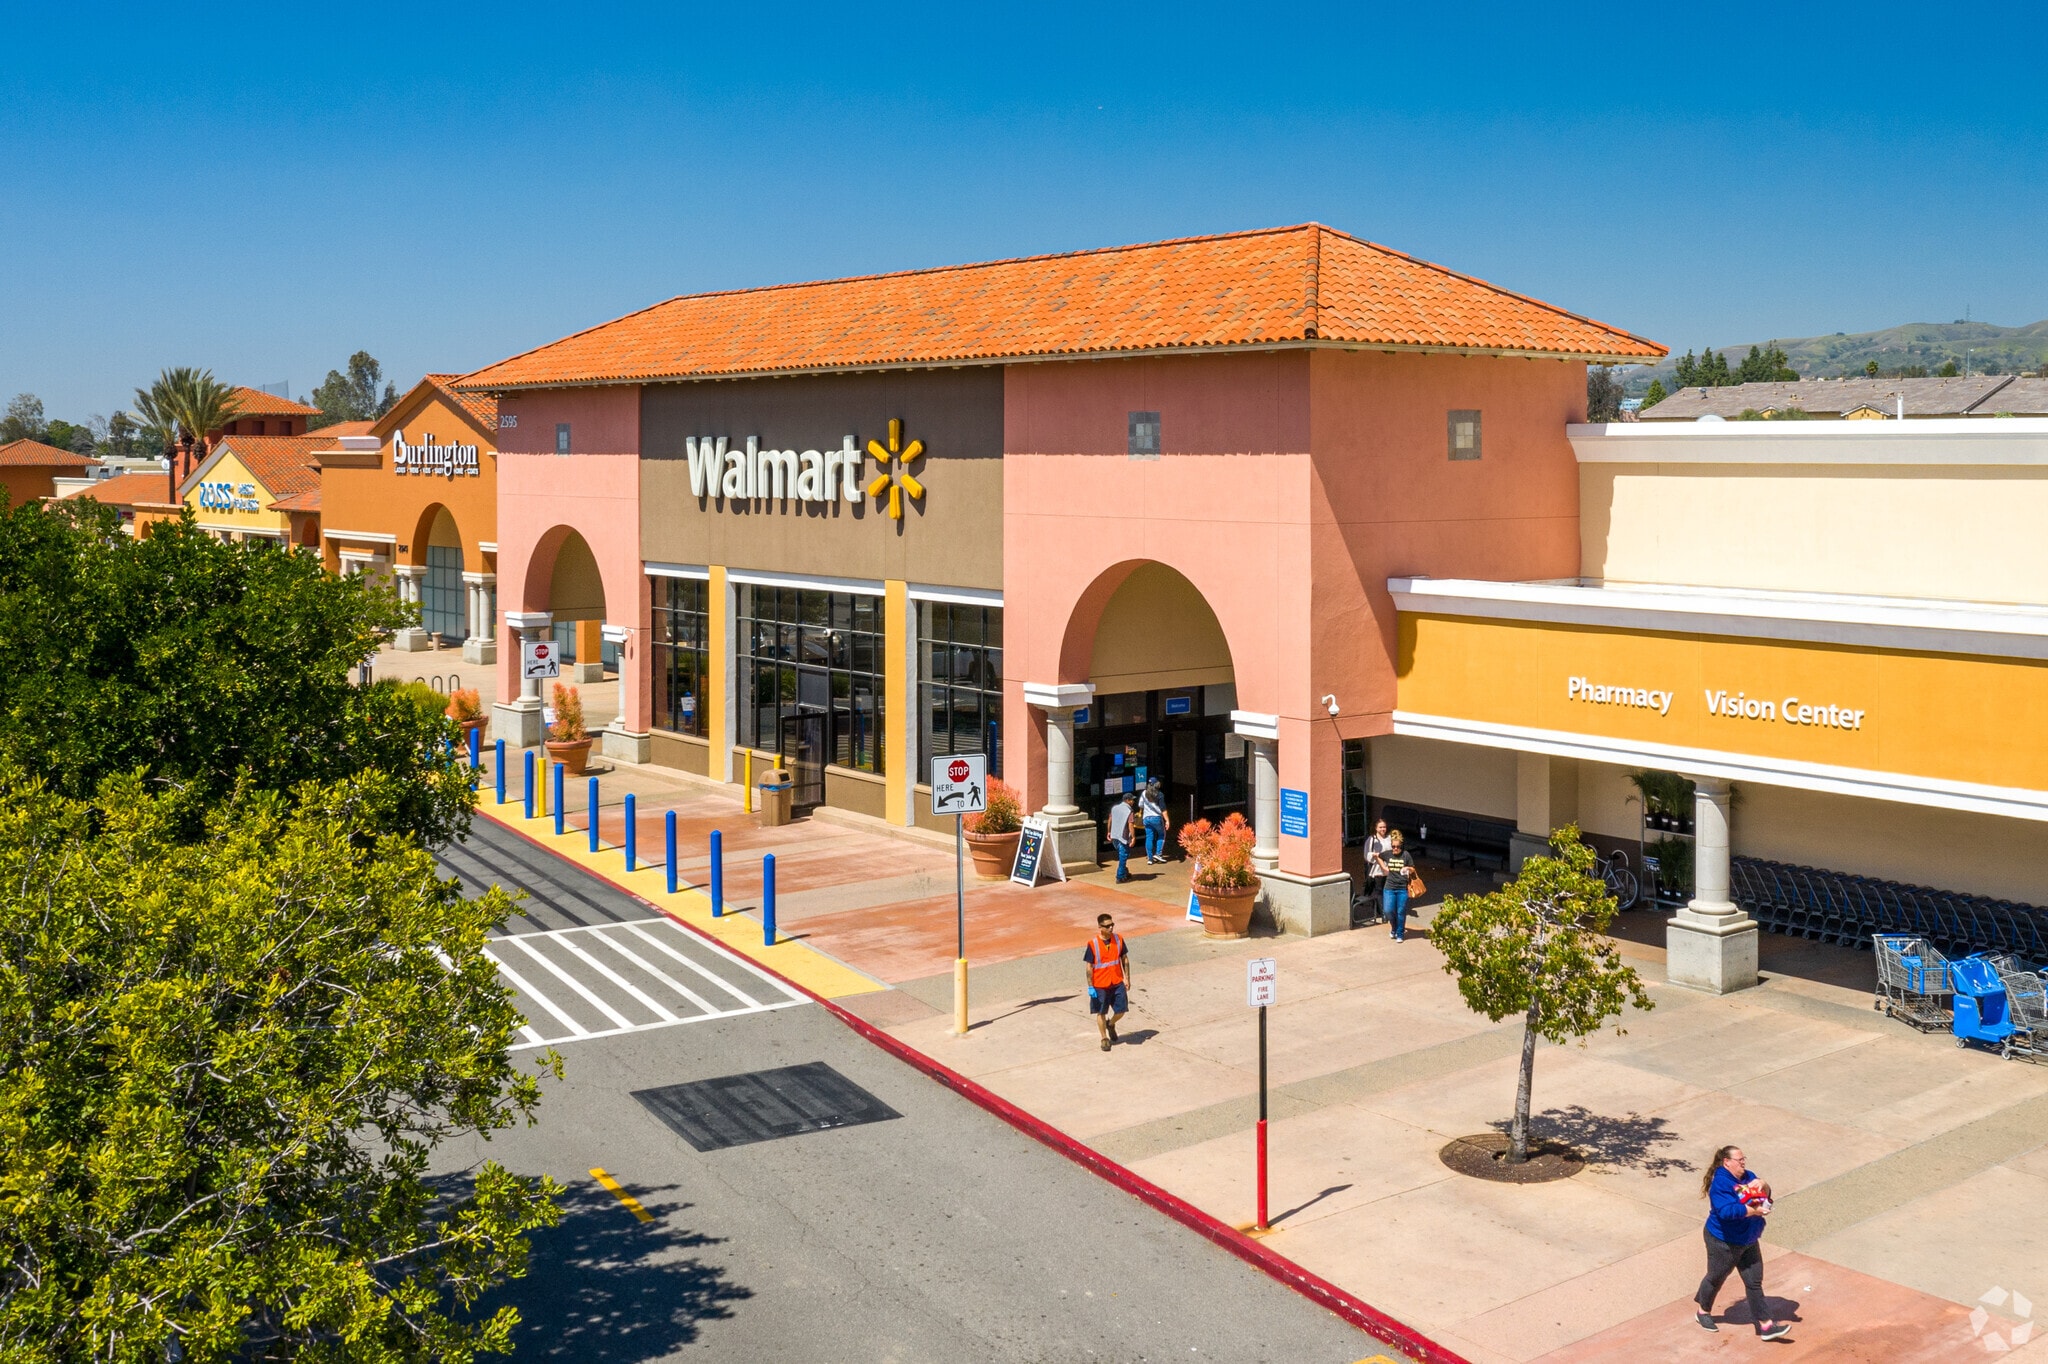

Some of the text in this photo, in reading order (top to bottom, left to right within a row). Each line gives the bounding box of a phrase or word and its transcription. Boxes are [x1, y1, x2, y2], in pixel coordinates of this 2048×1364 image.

[500, 415, 517, 428] 2595
[393, 429, 477, 476] Burlington
[686, 435, 862, 503] Walmart
[200, 482, 233, 509] ROSS
[1568, 676, 1673, 714] Pharmacy
[1705, 689, 1865, 728] Vision Center
[949, 766, 969, 777] STOP
[936, 784, 954, 792] HERE
[956, 800, 965, 808] TO
[1258, 966, 1267, 974] NO
[1251, 974, 1274, 983] PARKING
